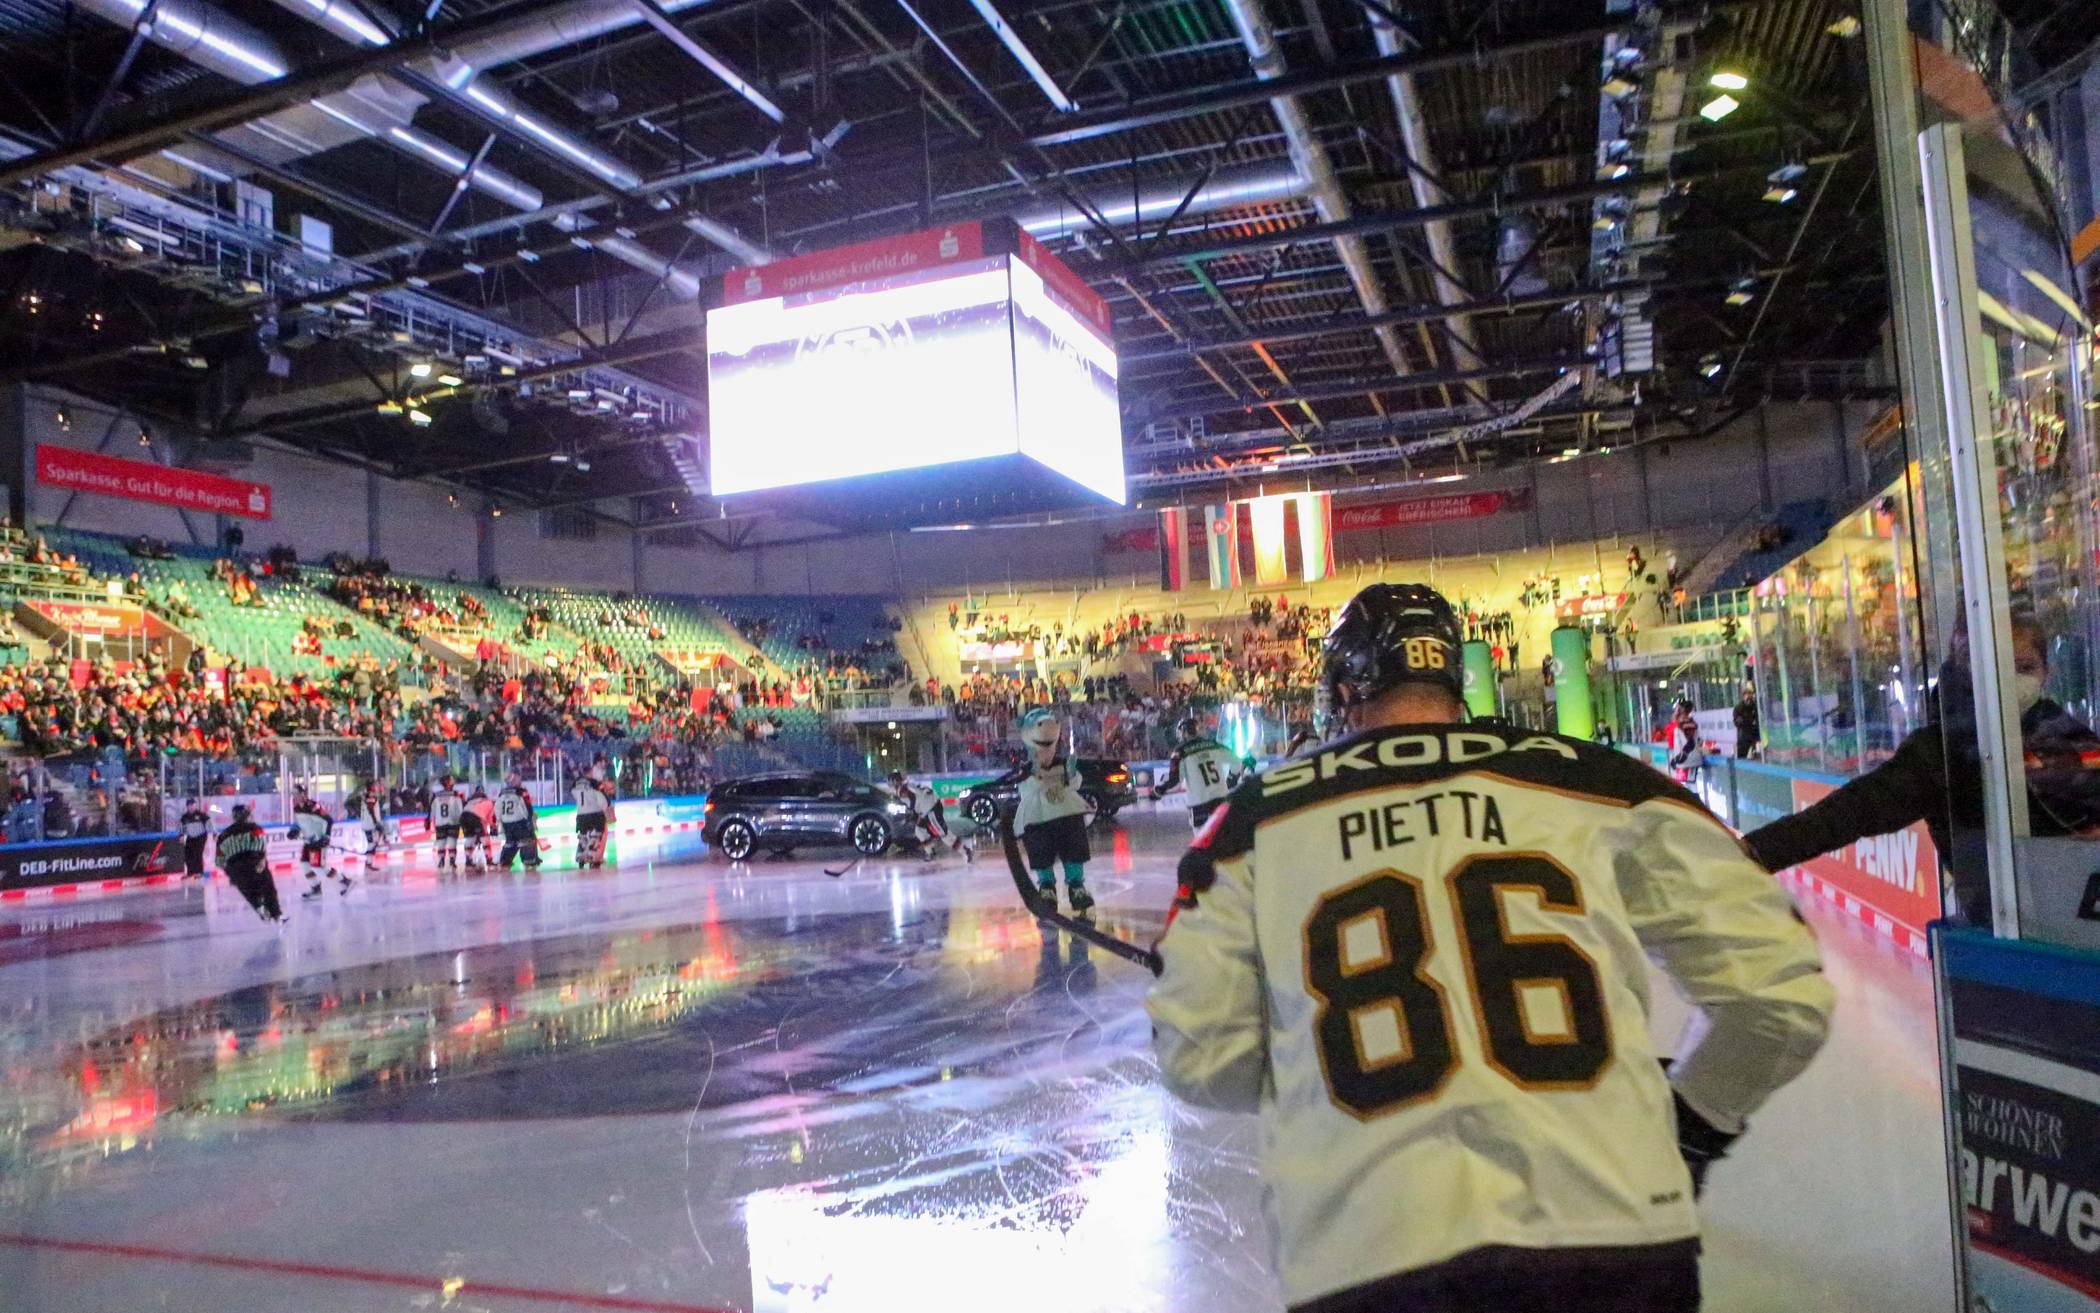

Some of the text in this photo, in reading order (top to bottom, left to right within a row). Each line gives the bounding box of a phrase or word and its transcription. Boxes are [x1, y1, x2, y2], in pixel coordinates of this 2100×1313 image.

[782, 252, 918, 289] sparkasse-krefeld.de
[127, 478, 150, 494] Gut
[152, 480, 173, 497] für
[176, 486, 194, 501] die
[1405, 640, 1445, 669] 86
[1198, 760, 1220, 787] 15
[440, 804, 449, 818] 8
[1338, 790, 1508, 861] PIETTA
[20, 856, 122, 876] DEB-FitLine.com
[1302, 850, 1616, 1124] 86
